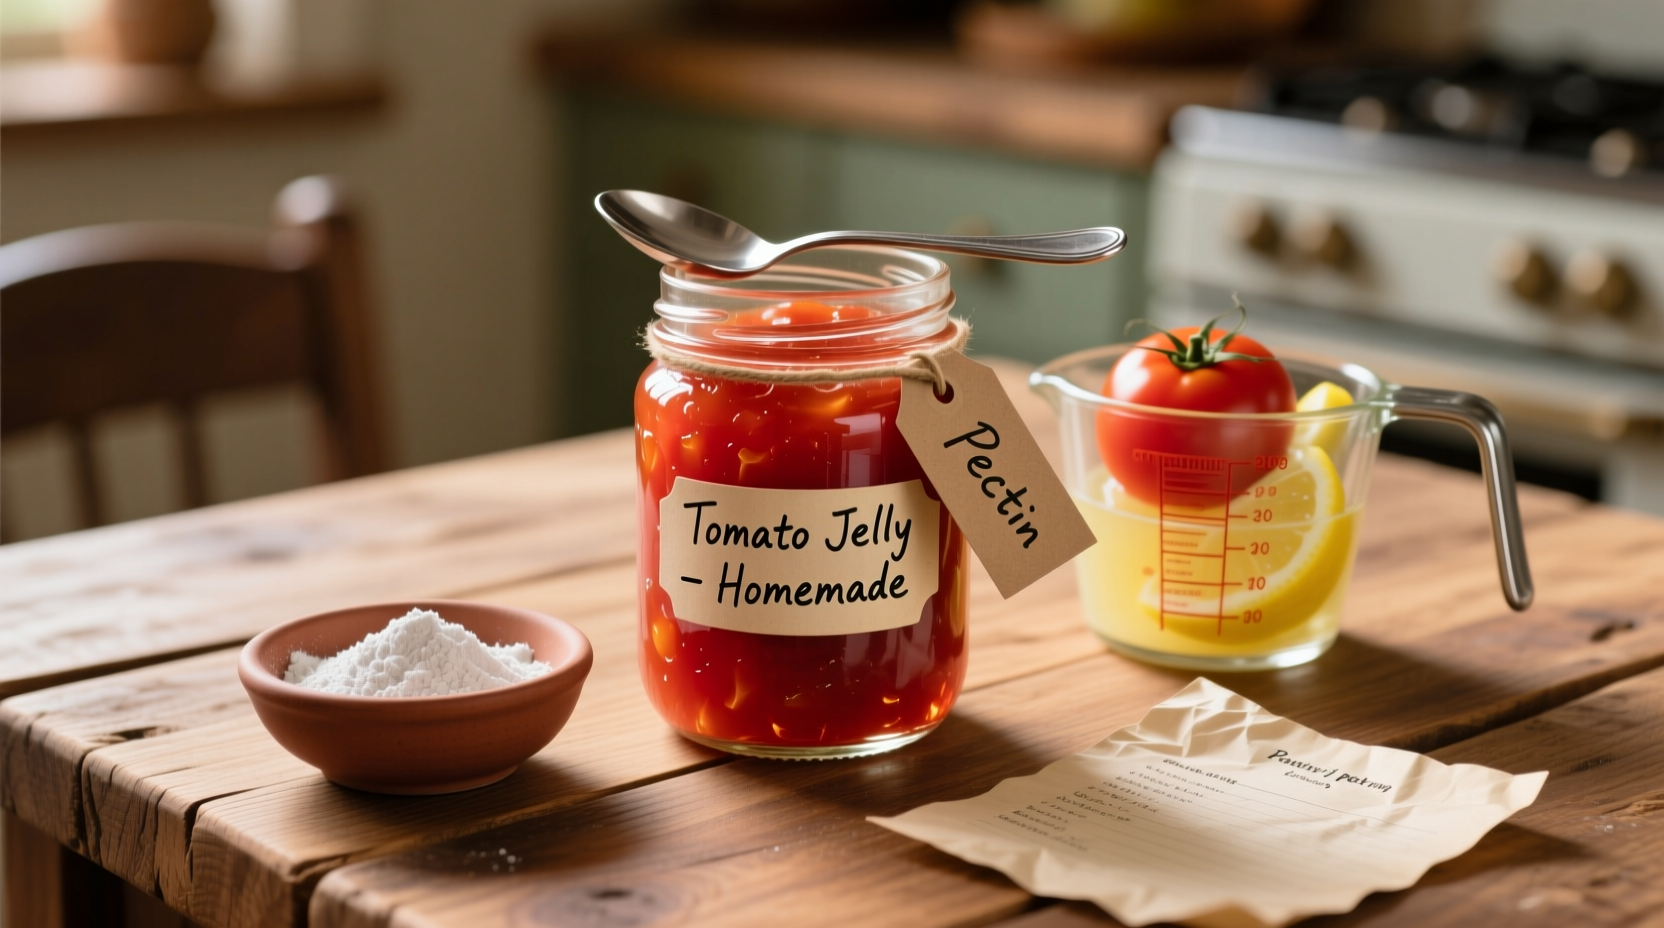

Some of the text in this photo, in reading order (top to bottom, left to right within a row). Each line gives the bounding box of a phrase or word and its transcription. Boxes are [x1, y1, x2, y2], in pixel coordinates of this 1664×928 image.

[943, 420, 1040, 549] Pectin
[683, 500, 912, 562] Tomato Jelly
[717, 560, 909, 609] Homemade
